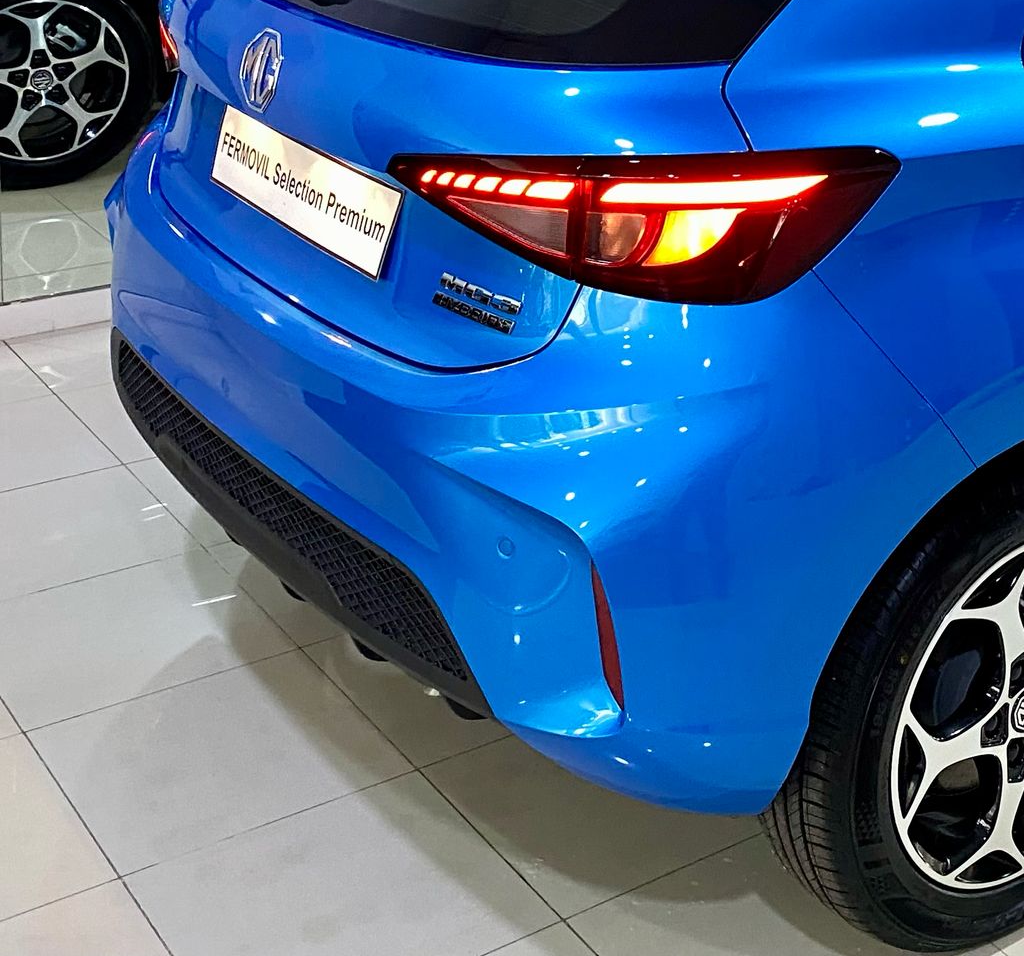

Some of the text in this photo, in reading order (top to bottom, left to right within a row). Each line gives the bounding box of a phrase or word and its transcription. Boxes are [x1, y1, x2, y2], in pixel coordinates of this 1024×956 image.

[241, 29, 281, 112] MG
[221, 131, 387, 243] FERMOVIL Selection Premium
